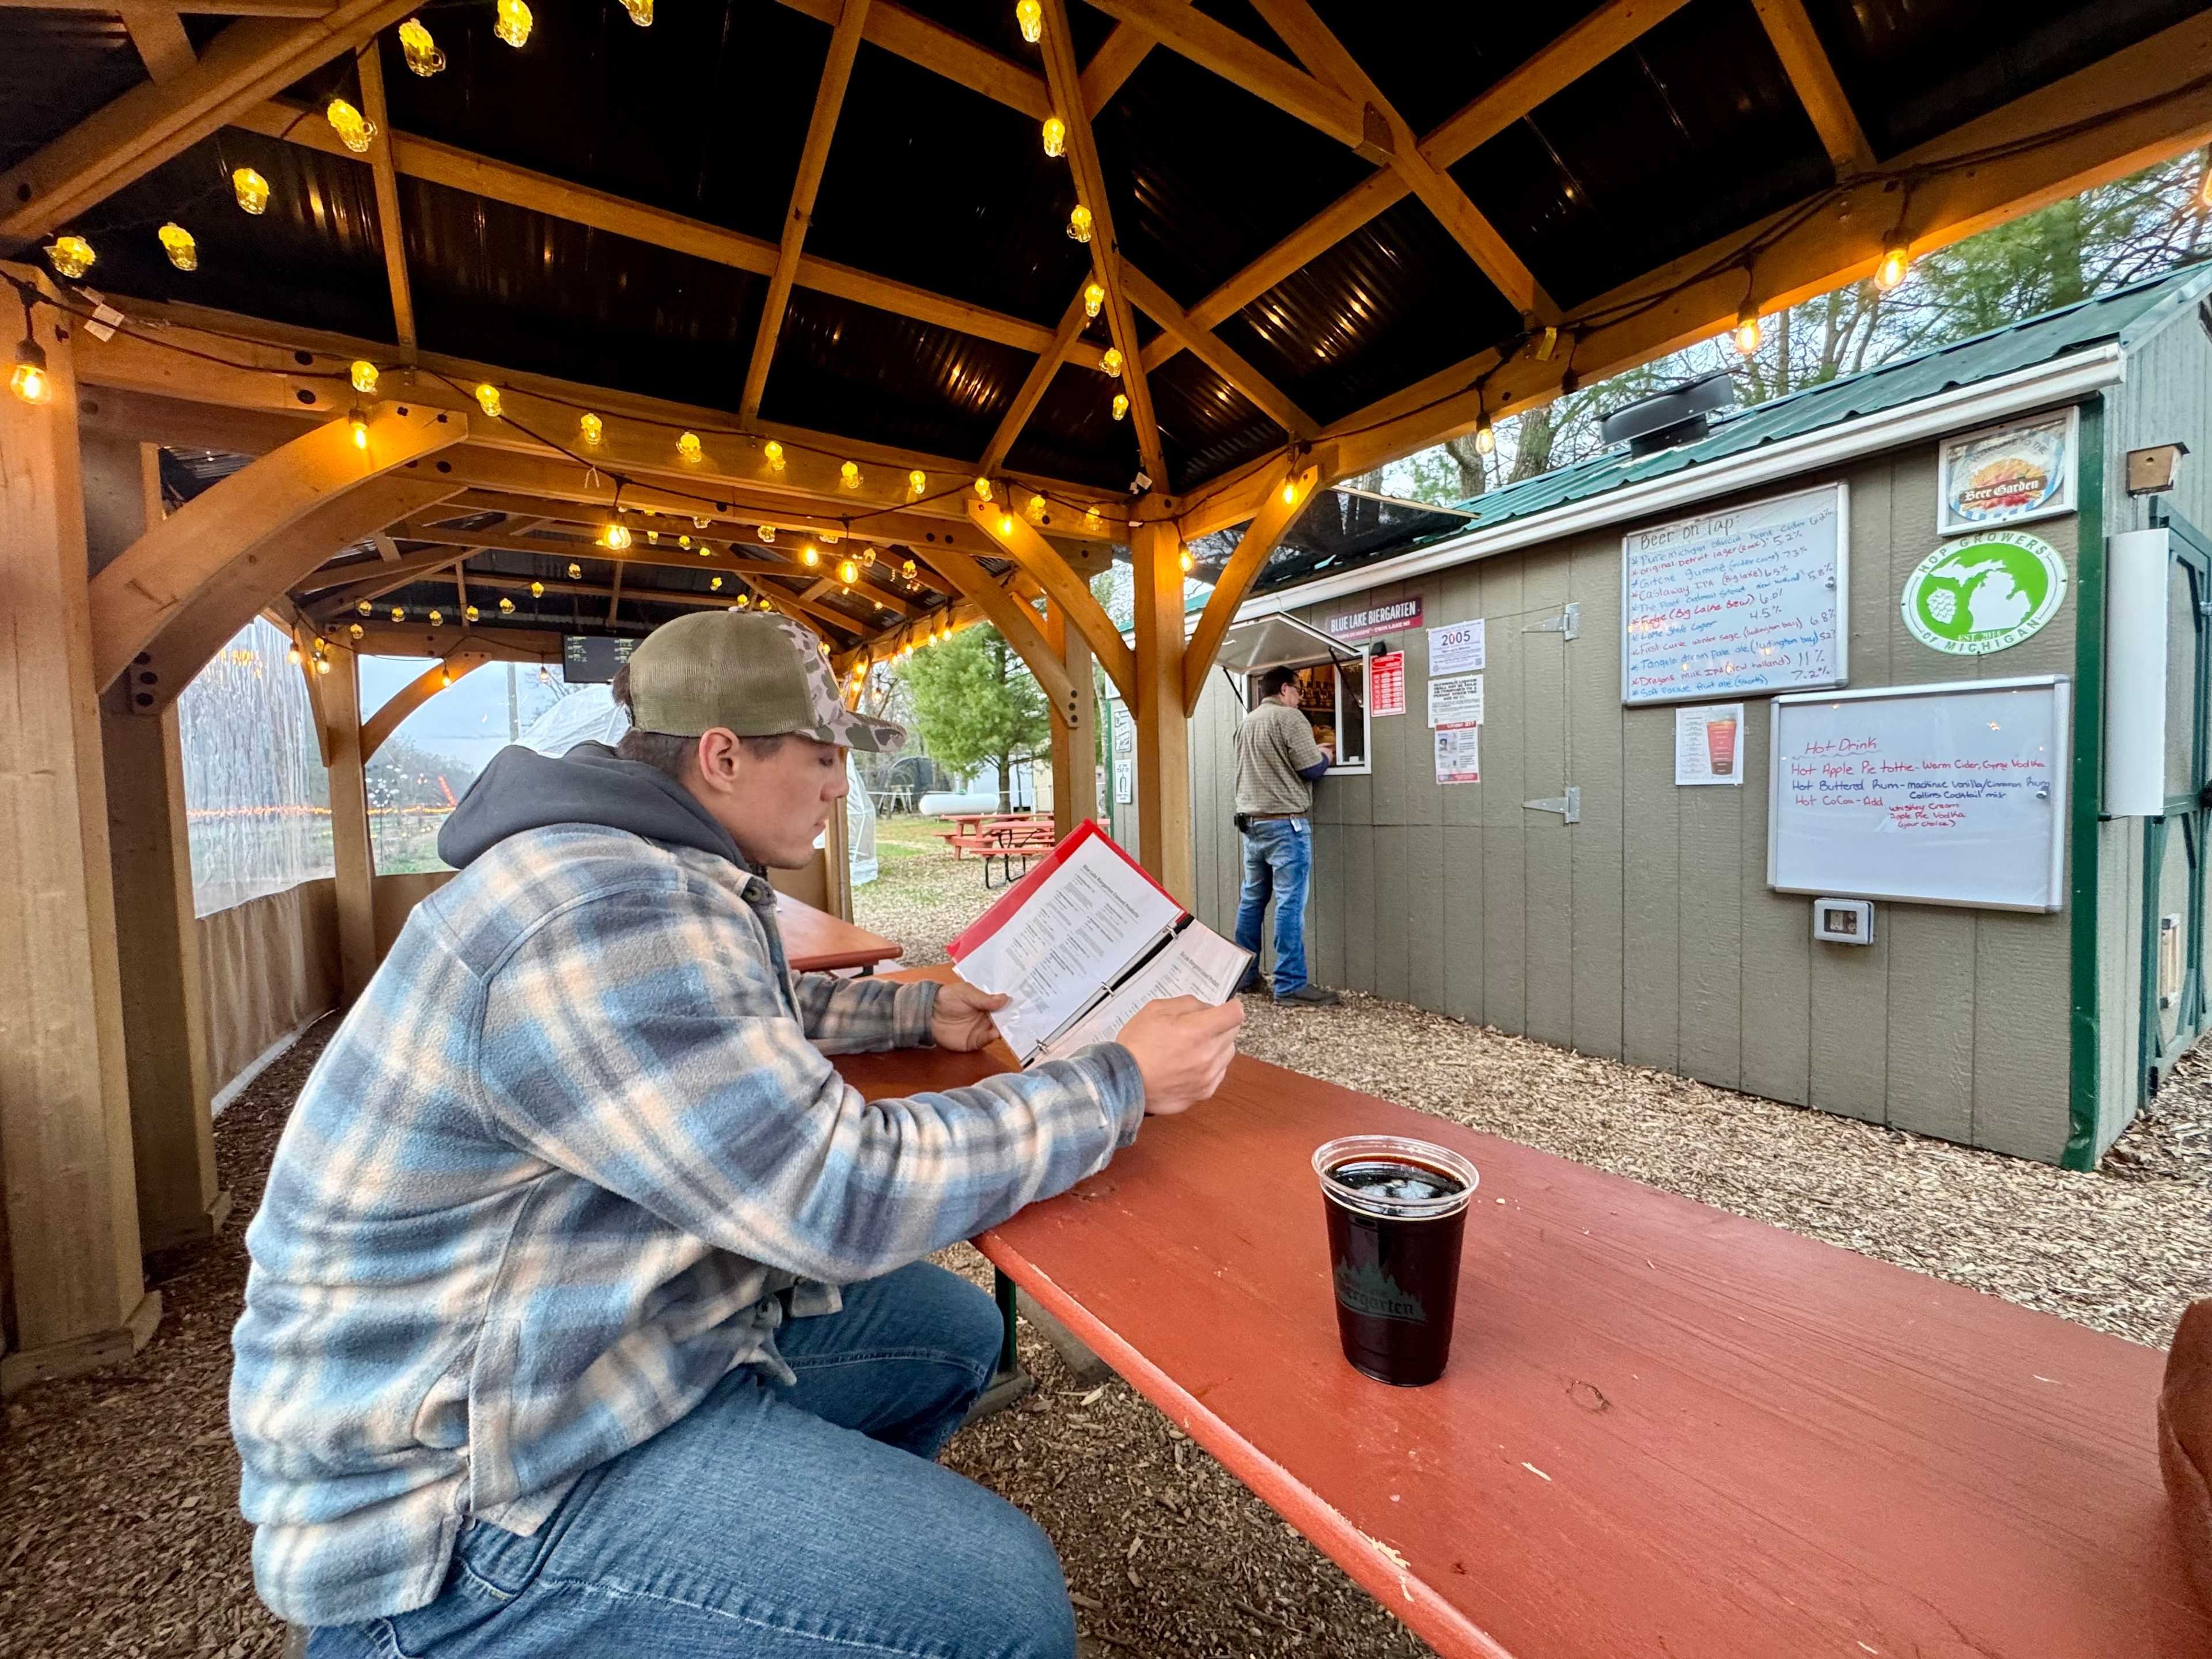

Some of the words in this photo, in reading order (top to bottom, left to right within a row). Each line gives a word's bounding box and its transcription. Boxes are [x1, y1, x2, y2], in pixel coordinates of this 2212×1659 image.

[1964, 488, 1993, 503] Beer
[1993, 480, 2039, 496] Garden
[1641, 530, 1675, 551] Beer
[1682, 525, 1700, 540] on
[1668, 545, 1706, 559] Michigan
[1677, 554, 1709, 567] Detroit
[1918, 547, 1948, 574] HOP
[1959, 531, 2050, 557] GROWERS
[1639, 585, 1690, 601] Castaway
[1694, 579, 1714, 589] IPA
[1330, 615, 1350, 633] BLUE
[1349, 611, 1368, 629] LAKE
[1368, 600, 1417, 625] BIERGARTEN
[1669, 607, 1691, 620] (Big
[1441, 630, 1471, 646] 2005
[1922, 631, 1938, 644] OF
[1944, 619, 2040, 652] MICHIGAN
[1804, 740, 1836, 755] Hot
[1838, 736, 1877, 752] Drink
[1790, 762, 1818, 776] Hot
[1822, 762, 1854, 778] Apple
[1861, 760, 1876, 775] Pie
[1922, 759, 1952, 770] Warm
[1792, 779, 1813, 791] Hot
[1819, 779, 1865, 791] Buttered
[1796, 794, 1817, 806] Hot
[1909, 791, 1942, 800] Collins
